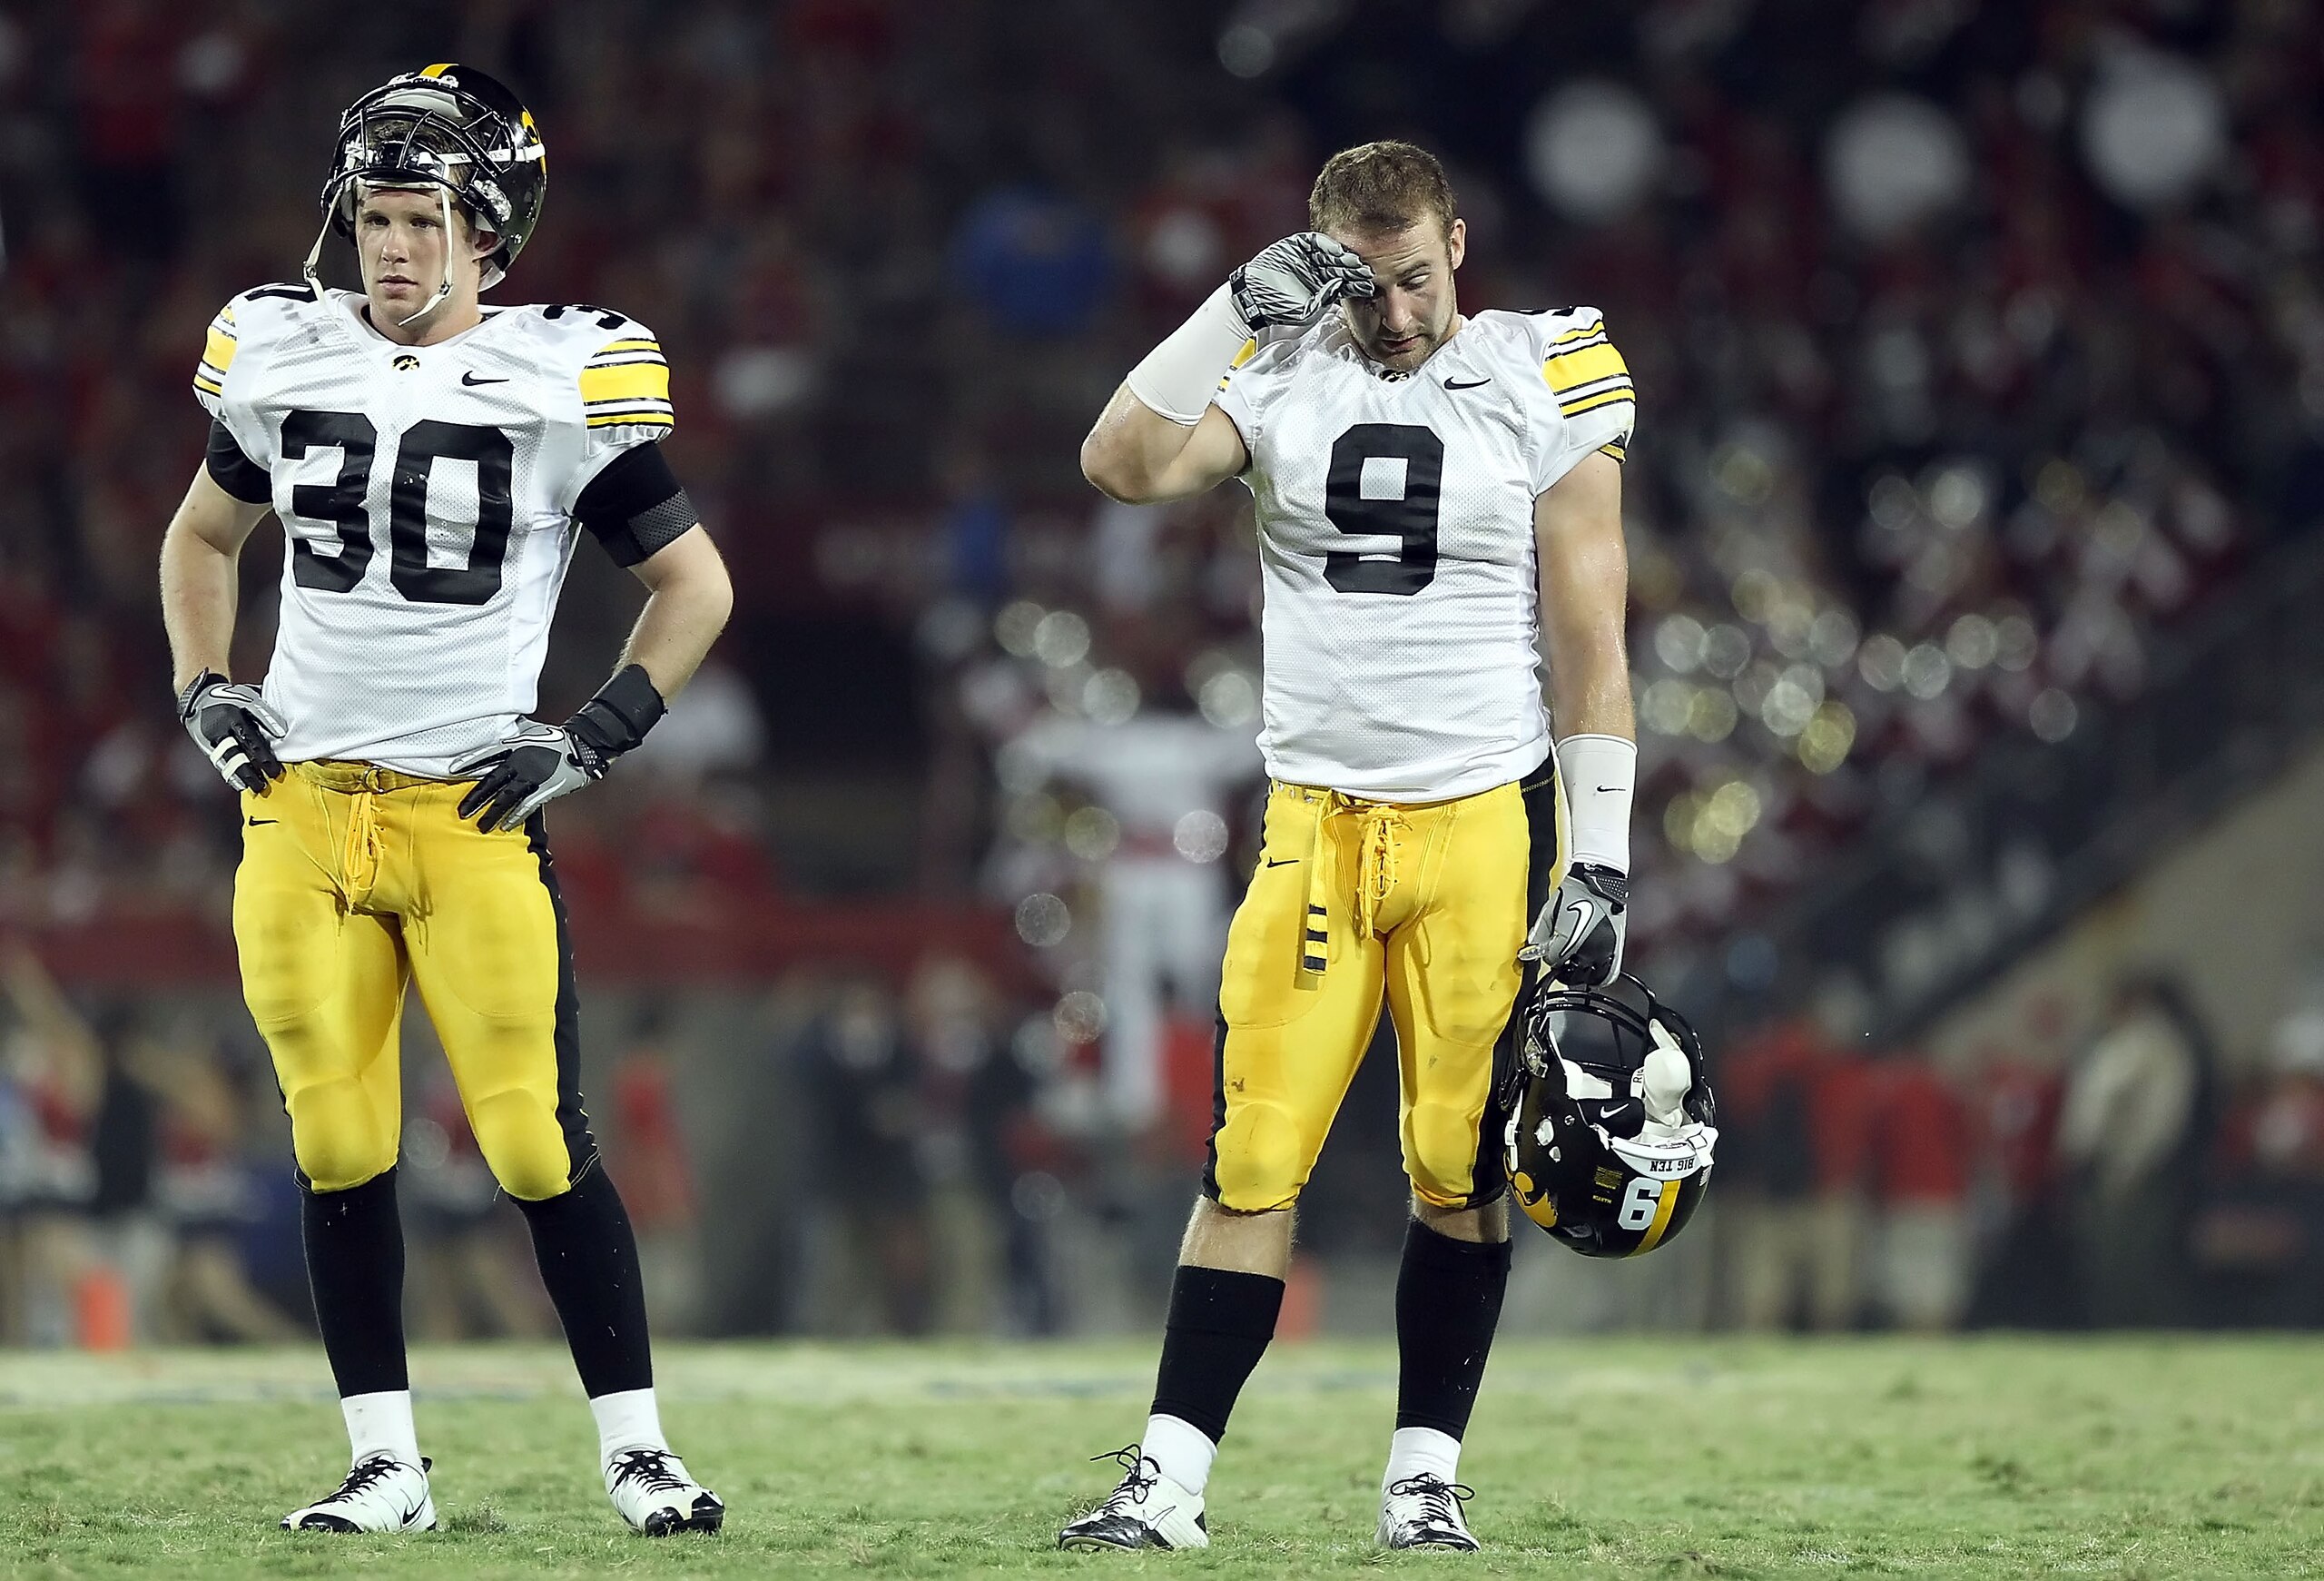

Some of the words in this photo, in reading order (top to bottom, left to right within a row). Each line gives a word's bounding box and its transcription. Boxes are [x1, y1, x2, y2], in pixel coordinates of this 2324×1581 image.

[281, 409, 514, 606] 30
[1323, 423, 1444, 596] 9
[1649, 1161, 1673, 1172] TEN
[1678, 1158, 1694, 1171] BIG
